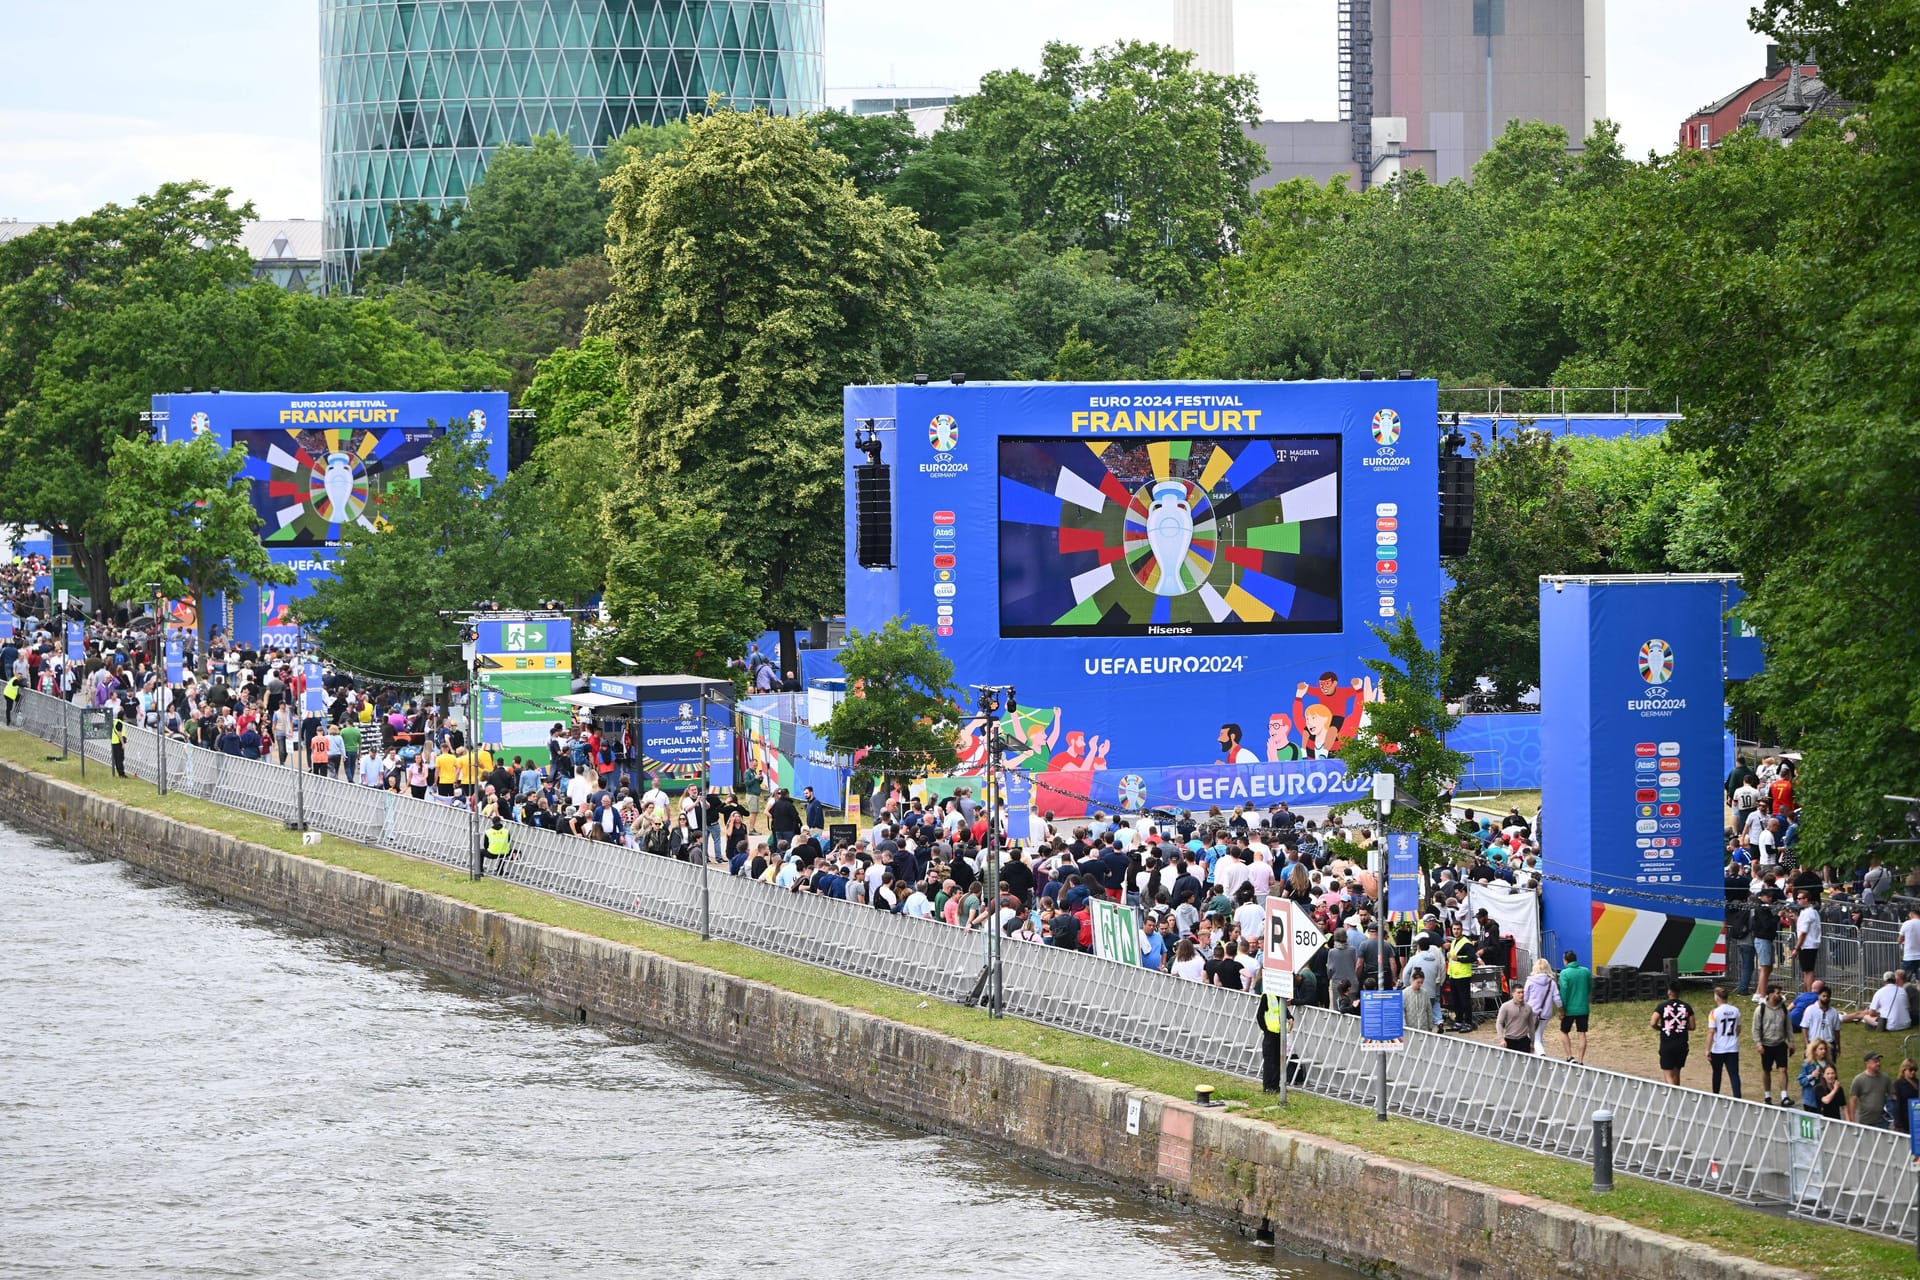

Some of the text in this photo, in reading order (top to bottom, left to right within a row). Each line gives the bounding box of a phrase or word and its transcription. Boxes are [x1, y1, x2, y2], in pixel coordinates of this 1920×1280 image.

[290, 400, 388, 408] EURO 2024 FESTIVAL
[1089, 395, 1243, 407] EURO 2024 FESTIVAL
[279, 409, 399, 423] FRANKFURT
[1071, 410, 1262, 432] FRANKFURT
[919, 463, 968, 472] EURO2024
[1362, 457, 1410, 466] EURO2024
[1148, 625, 1193, 635] Hisense
[1628, 699, 1686, 710] EURO2024
[316, 742, 324, 752] 10
[647, 737, 685, 746] OFFICIAL
[1177, 771, 1374, 801] UEFAEURO202
[1776, 787, 1784, 800] 7
[1741, 794, 1752, 808] 10
[1271, 915, 1284, 952] P
[1295, 930, 1318, 947] 580
[1720, 1017, 1737, 1037] 13
[1801, 1119, 1811, 1138] 11
